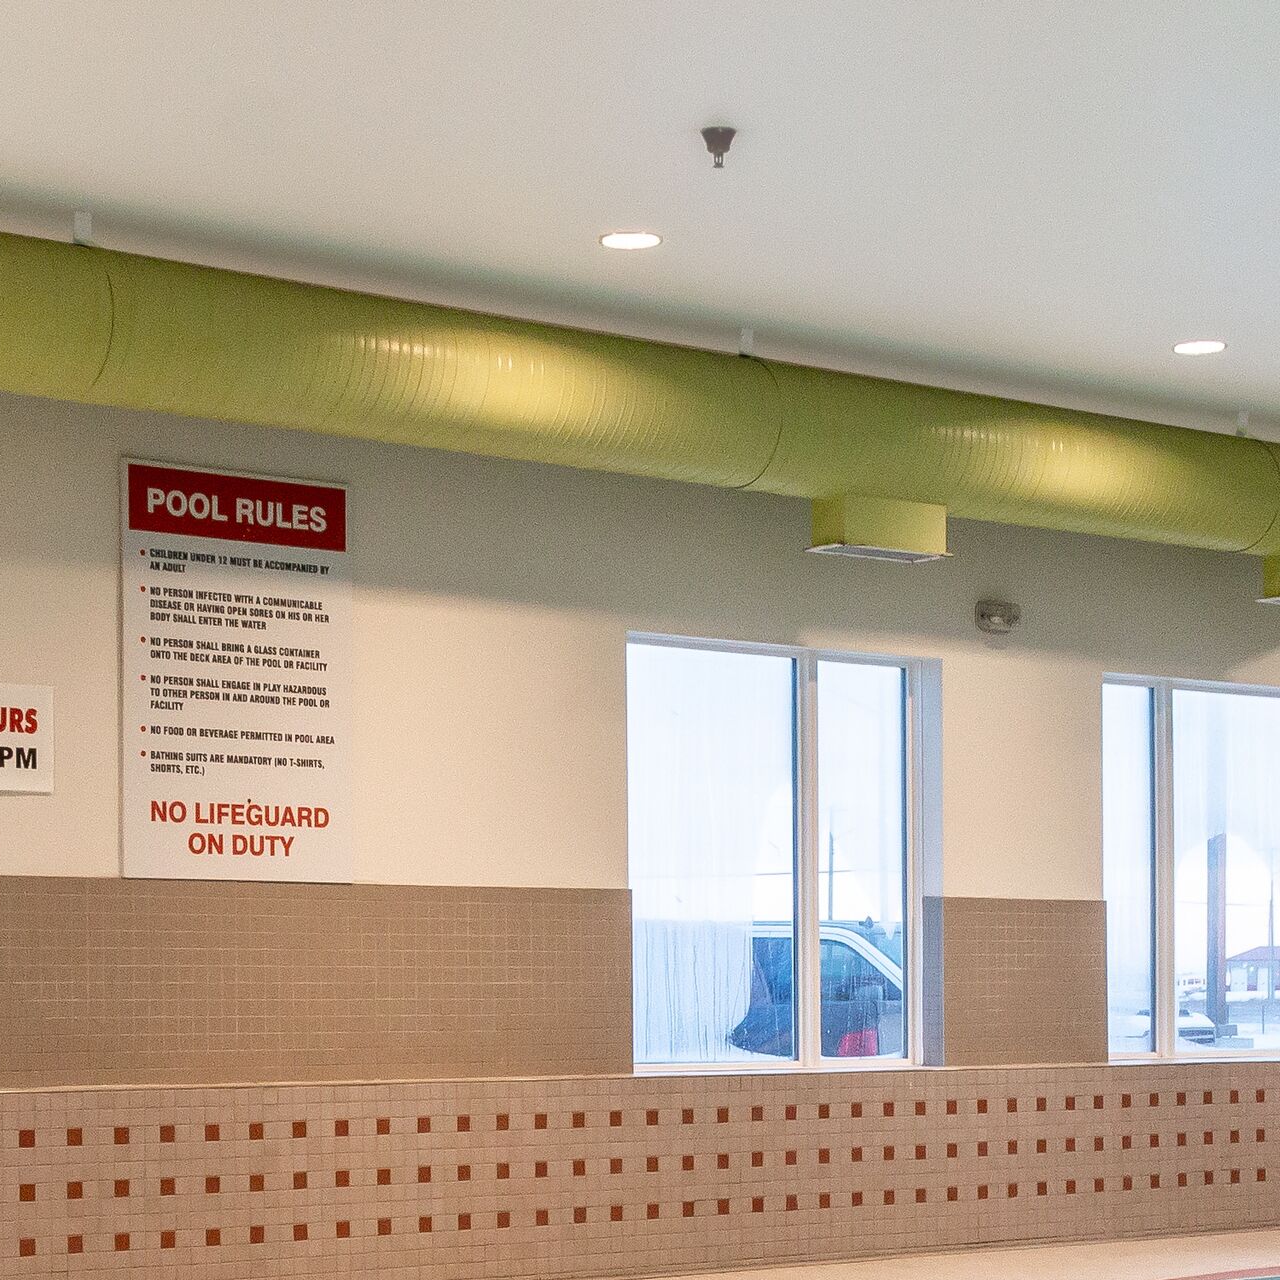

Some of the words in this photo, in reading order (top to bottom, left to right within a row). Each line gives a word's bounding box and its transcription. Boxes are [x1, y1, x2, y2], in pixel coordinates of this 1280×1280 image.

[147, 487, 227, 521] POOL
[236, 497, 327, 532] RULES
[150, 549, 188, 561] CHILDREN
[190, 553, 216, 564] UNDER
[230, 556, 251, 567] MUST
[253, 559, 262, 568] BE
[264, 560, 318, 573] ACCOMPANIED
[320, 565, 330, 575] BY
[150, 562, 160, 571] AN
[162, 563, 186, 573] ADULT
[150, 587, 161, 597] NO
[163, 588, 193, 599] PERSON
[195, 591, 232, 603] INFECTED
[234, 594, 253, 605] WITH
[256, 596, 261, 605] A
[263, 597, 323, 610] COMMUNICABLE
[150, 600, 181, 611] DISEASE
[184, 603, 195, 612] OR
[197, 604, 225, 615] HAVING
[227, 606, 247, 616] OPEN
[249, 608, 273, 618] SORES
[275, 610, 285, 619] ON
[288, 611, 300, 621] HIS
[302, 612, 312, 622] OR
[315, 613, 330, 623] HER
[150, 613, 170, 623] BODY
[173, 614, 196, 625] SHALL
[198, 616, 222, 627] ENTER
[225, 619, 238, 628] THE
[241, 620, 267, 630] WATER
[150, 638, 161, 647] NO
[163, 639, 193, 650] PERSON
[196, 641, 219, 651] SHALL
[221, 643, 244, 653] BRING
[247, 645, 252, 654] A
[254, 645, 277, 655] GLASS
[279, 647, 321, 659] CONTAINER
[150, 650, 171, 661] ONTO
[174, 652, 187, 662] THE
[190, 653, 210, 663] DECK
[212, 655, 231, 665] AREA
[234, 656, 243, 666] OF
[246, 657, 260, 667] THE
[262, 658, 281, 668] POOL
[283, 660, 294, 669] OR
[296, 661, 328, 672] FACILITY
[150, 675, 161, 685] NO
[163, 676, 194, 687] PERSON
[196, 678, 219, 689] SHALL
[221, 680, 250, 691] ENGAGE
[253, 682, 261, 691] IN
[263, 683, 281, 692] PLAY
[283, 684, 328, 695] HAZARDOUS
[150, 688, 160, 697] TO
[162, 689, 187, 699] OTHER
[190, 691, 220, 701] PERSON
[222, 693, 230, 702] IN
[232, 693, 248, 703] AND
[250, 694, 280, 705] AROUND
[282, 697, 296, 706] THE
[298, 698, 317, 707] POOL
[319, 699, 330, 708] OR
[150, 701, 185, 711] FACILITY
[150, 726, 161, 735] NO
[163, 727, 184, 736] FOOD
[186, 728, 197, 737] OR
[199, 729, 238, 739] BEVERAGE
[240, 731, 283, 742] PERMITTED
[284, 733, 292, 742] IN
[295, 734, 313, 743] POOL
[316, 735, 335, 745] AREA
[150, 751, 183, 761] BATHING
[186, 753, 207, 763] SUITS
[209, 754, 224, 764] ARE
[226, 755, 272, 766] MANDATORY
[150, 800, 186, 823] NO
[195, 802, 329, 828] LIFEGUARD
[188, 833, 222, 855] ON
[232, 835, 294, 857] DUTY
